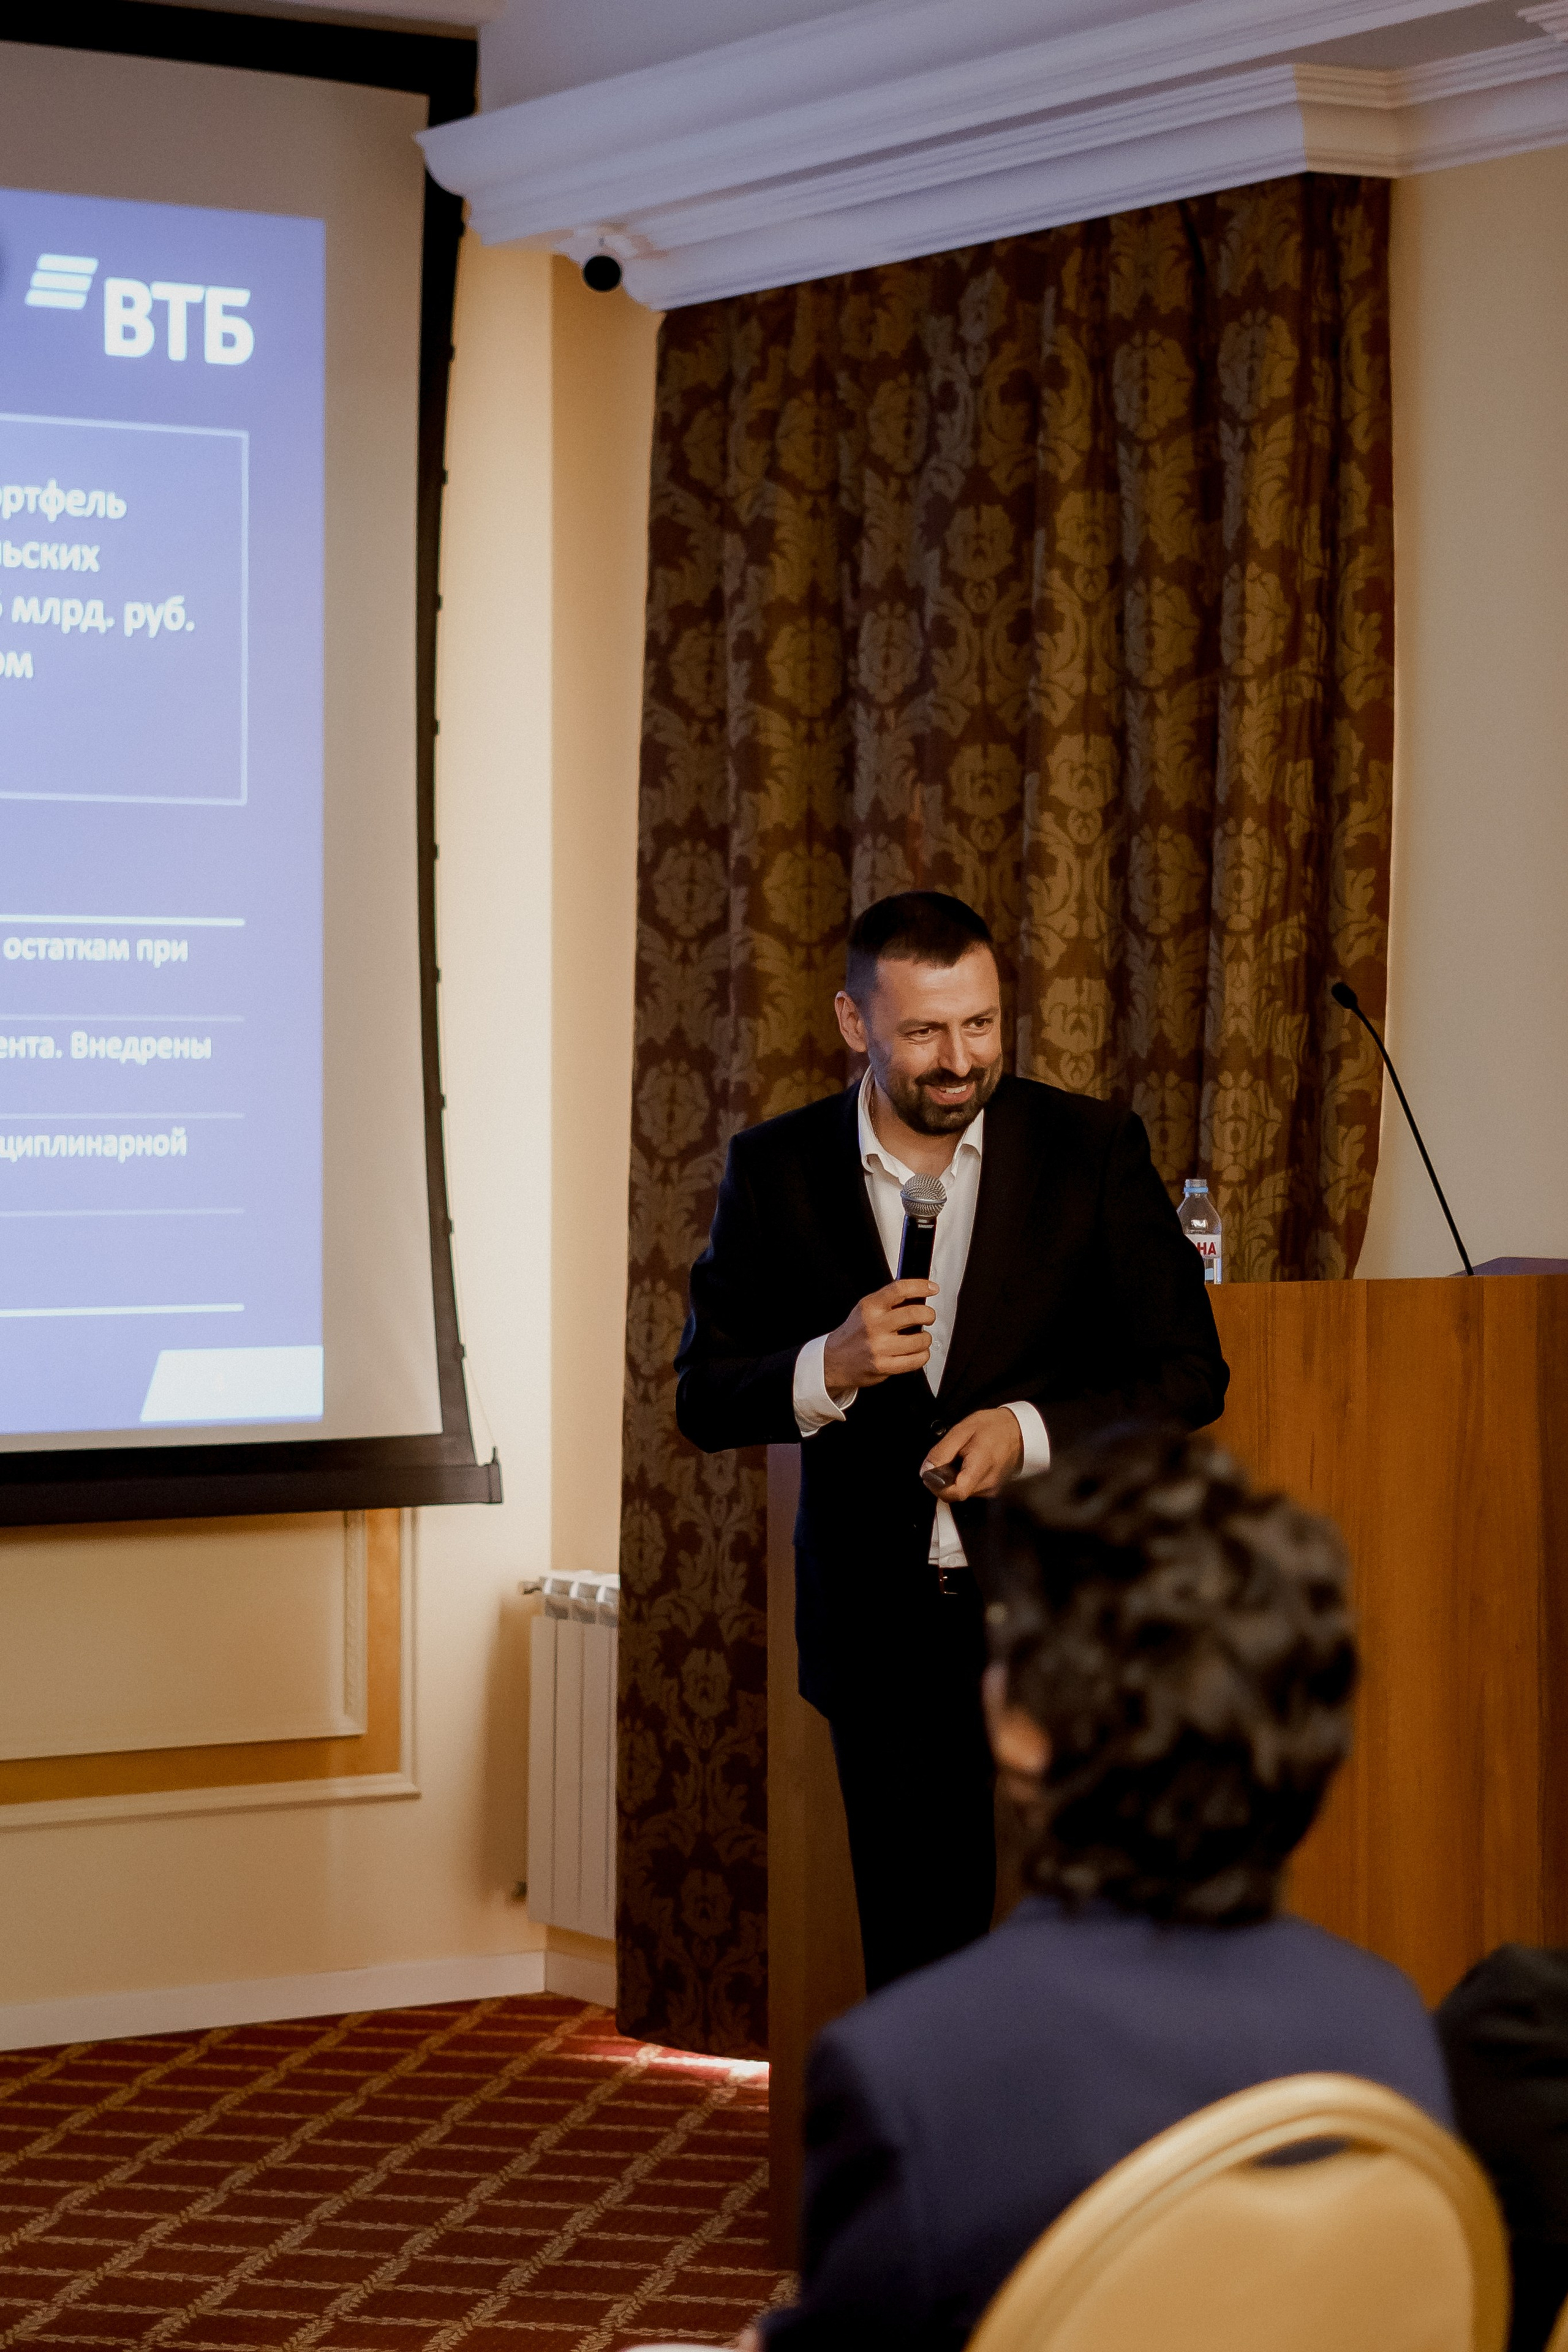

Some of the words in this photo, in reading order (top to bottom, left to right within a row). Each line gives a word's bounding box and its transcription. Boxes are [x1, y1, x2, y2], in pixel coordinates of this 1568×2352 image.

[104, 276, 254, 366] ВТБ
[0, 478, 127, 522] ртфель
[0, 540, 100, 572] ьских
[12, 596, 115, 634] млрд.
[124, 595, 195, 638] руб.
[0, 650, 34, 679] м
[3, 937, 129, 962] остаткам
[136, 938, 189, 968] при
[70, 1030, 212, 1066] Внедрены
[0, 1126, 187, 1164] циплинарной
